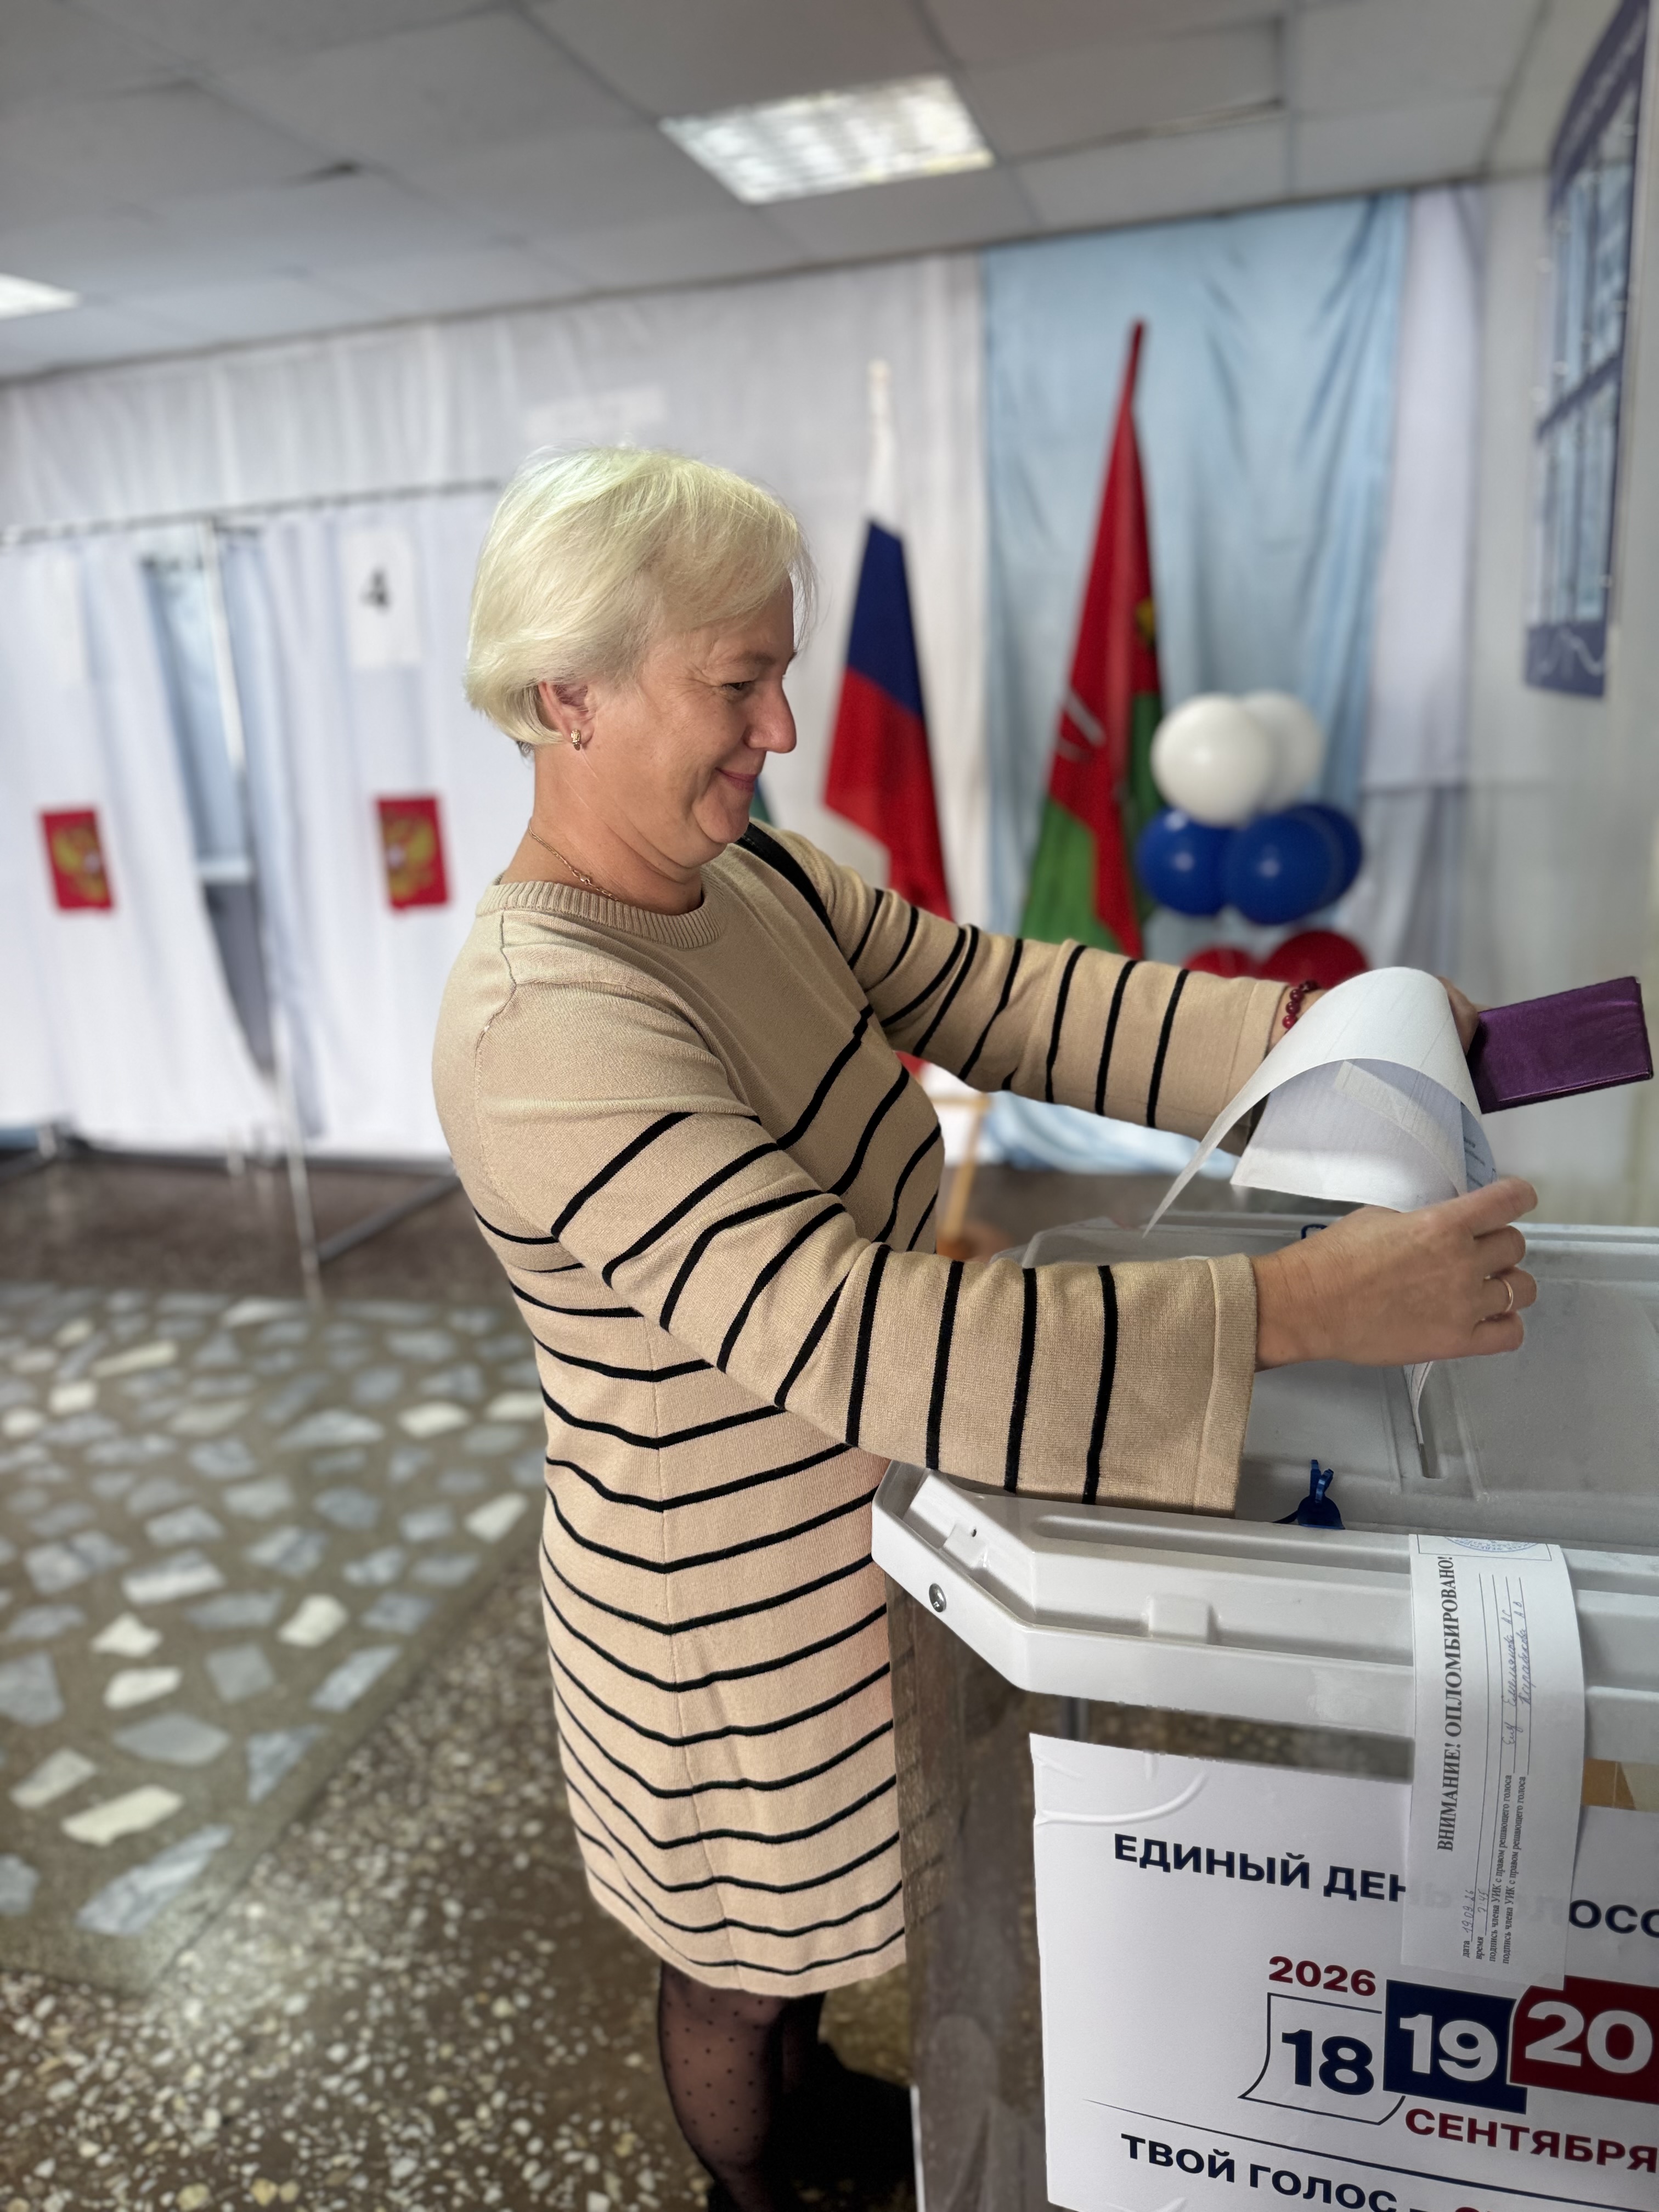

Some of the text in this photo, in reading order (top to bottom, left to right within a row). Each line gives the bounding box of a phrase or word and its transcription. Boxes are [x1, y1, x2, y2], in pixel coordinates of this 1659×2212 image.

[1437, 1556, 1462, 1850] ВНИМАНИЕ! ОПЛОМБИРОВАНО!
[1503, 1775, 1512, 1802] голоса
[1517, 1776, 1526, 1803] голоса
[1499, 1803, 1511, 1848] решающего
[1513, 1805, 1525, 1850] решающего
[1114, 1833, 1310, 1890] ЕДИНЫЙ
[1323, 1865, 1407, 1903] ДЕН
[1496, 1850, 1505, 1876] правом
[1509, 1852, 1519, 1878] правом
[1491, 1883, 1502, 1903] УИК
[1504, 1886, 1515, 1905] УИК
[1492, 1905, 1500, 1927] члена
[1505, 1907, 1514, 1929] члена
[1462, 1940, 1471, 1958] дата
[1475, 1936, 1485, 1960] время
[1488, 1929, 1498, 1962] подпись
[1502, 1932, 1511, 1964] подпись
[1268, 1956, 1376, 1996] 2026
[1281, 2000, 1653, 2096] 18 19 20
[1405, 2108, 1658, 2173] СЕНТЯБРЯ
[1121, 2133, 1397, 2212] ТВОЙ ГОЛОС
